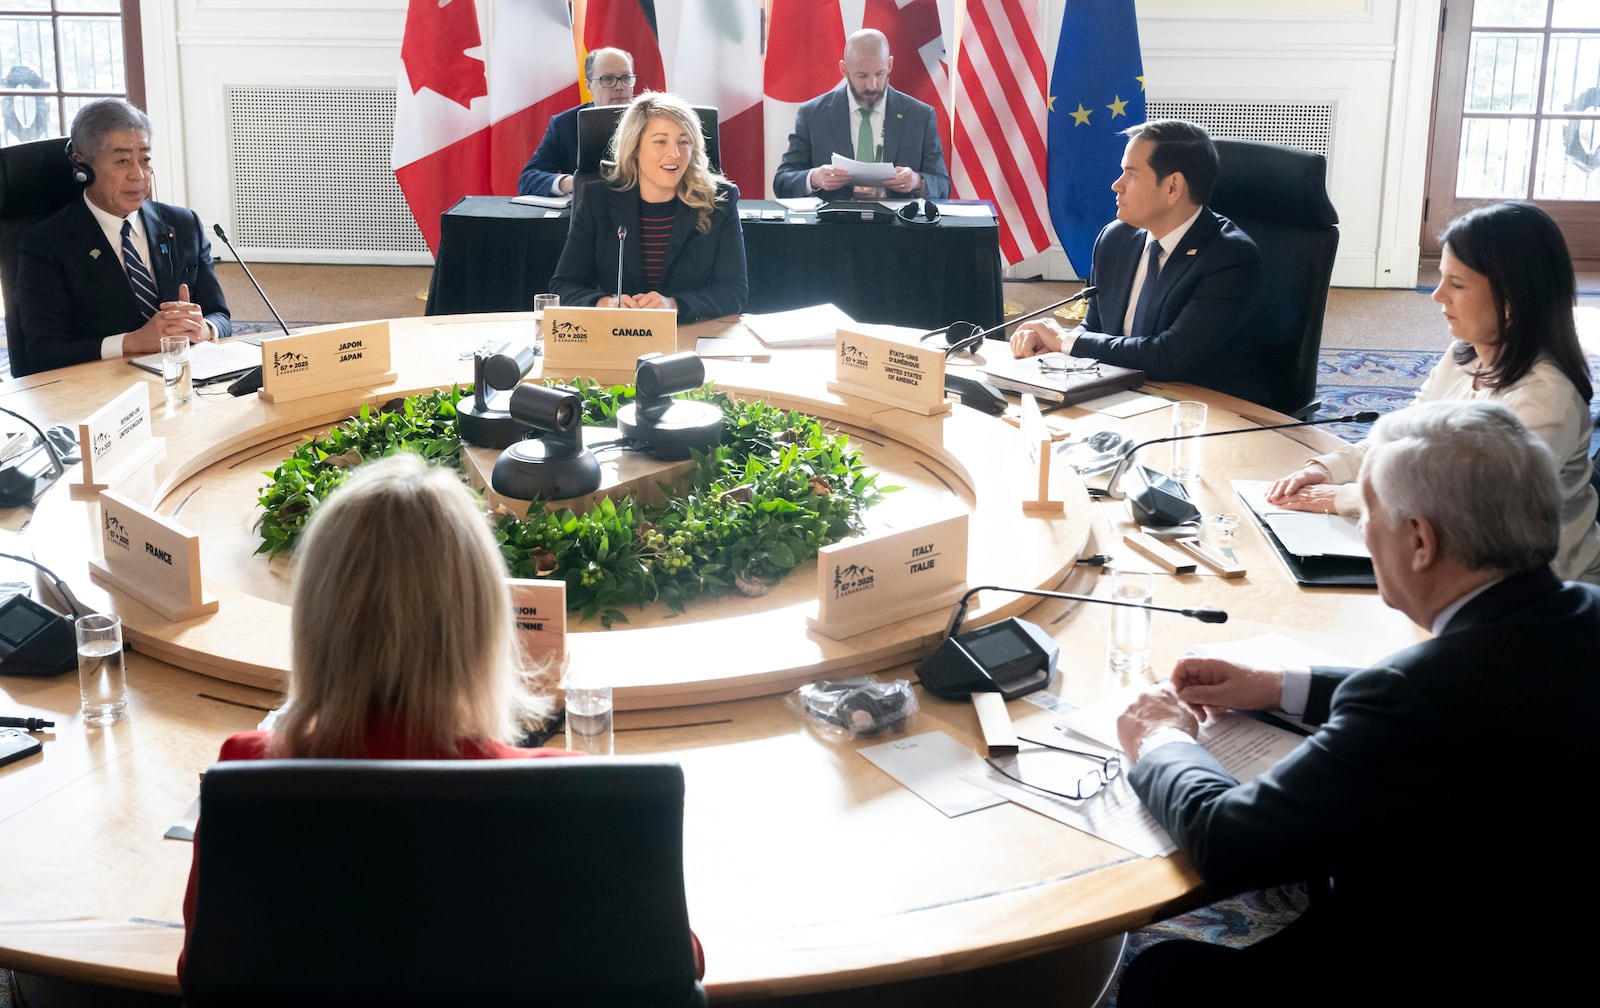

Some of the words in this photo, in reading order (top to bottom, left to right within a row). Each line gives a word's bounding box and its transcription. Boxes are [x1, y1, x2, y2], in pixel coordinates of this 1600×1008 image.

[612, 328, 652, 336] CANADA
[338, 340, 362, 350] JAPON
[339, 352, 362, 362] JAPAN
[889, 349, 918, 362] ÉTATS-UNIS
[294, 361, 309, 369] 2025
[856, 359, 868, 367] 2025
[884, 366, 903, 376] UNITED
[903, 370, 922, 380] STATES
[895, 376, 919, 386] AMERICA
[145, 542, 172, 566] FRANCE
[912, 544, 934, 557] ITALY
[910, 560, 934, 574] ITALIE
[841, 582, 850, 591] G7
[857, 576, 874, 586] 2025
